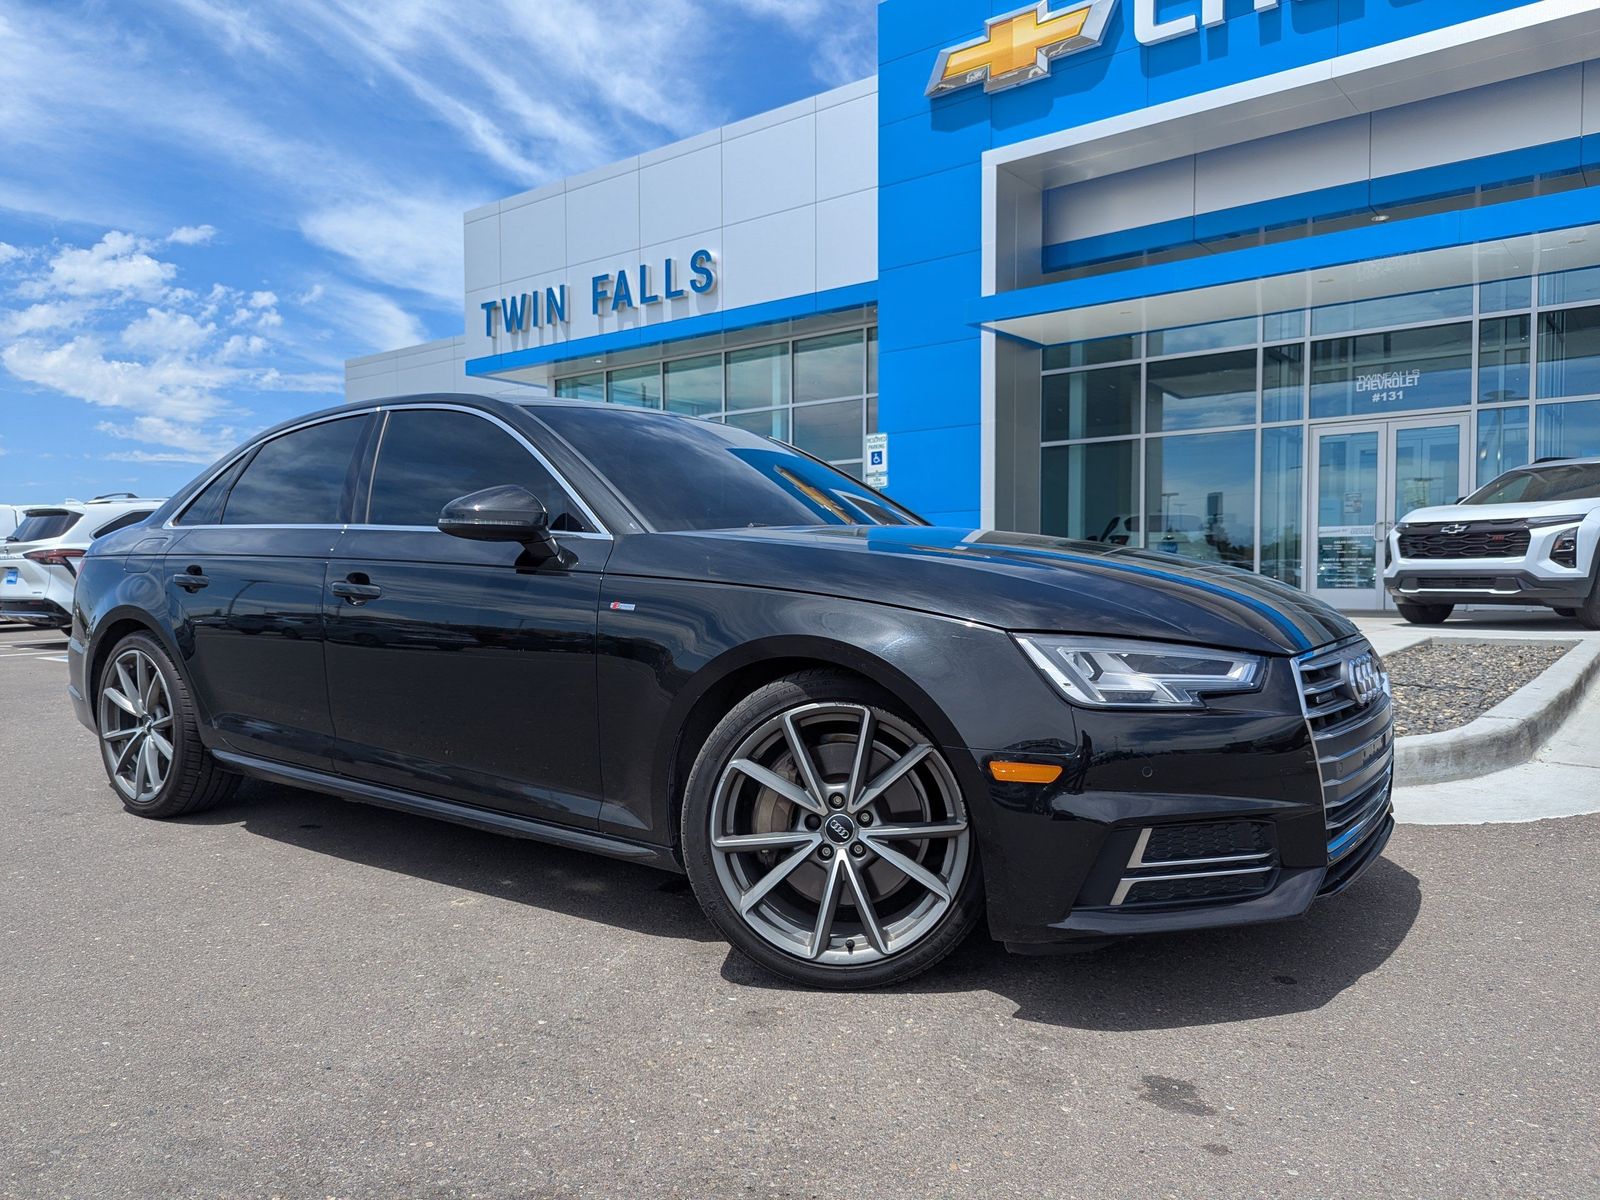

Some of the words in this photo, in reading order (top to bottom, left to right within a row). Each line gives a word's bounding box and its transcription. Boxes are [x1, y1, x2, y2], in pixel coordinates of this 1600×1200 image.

[481, 284, 569, 338] TWIN
[591, 249, 718, 316] FALLS
[1356, 375, 1420, 392] CHEVROLET
[1372, 390, 1403, 402] #131
